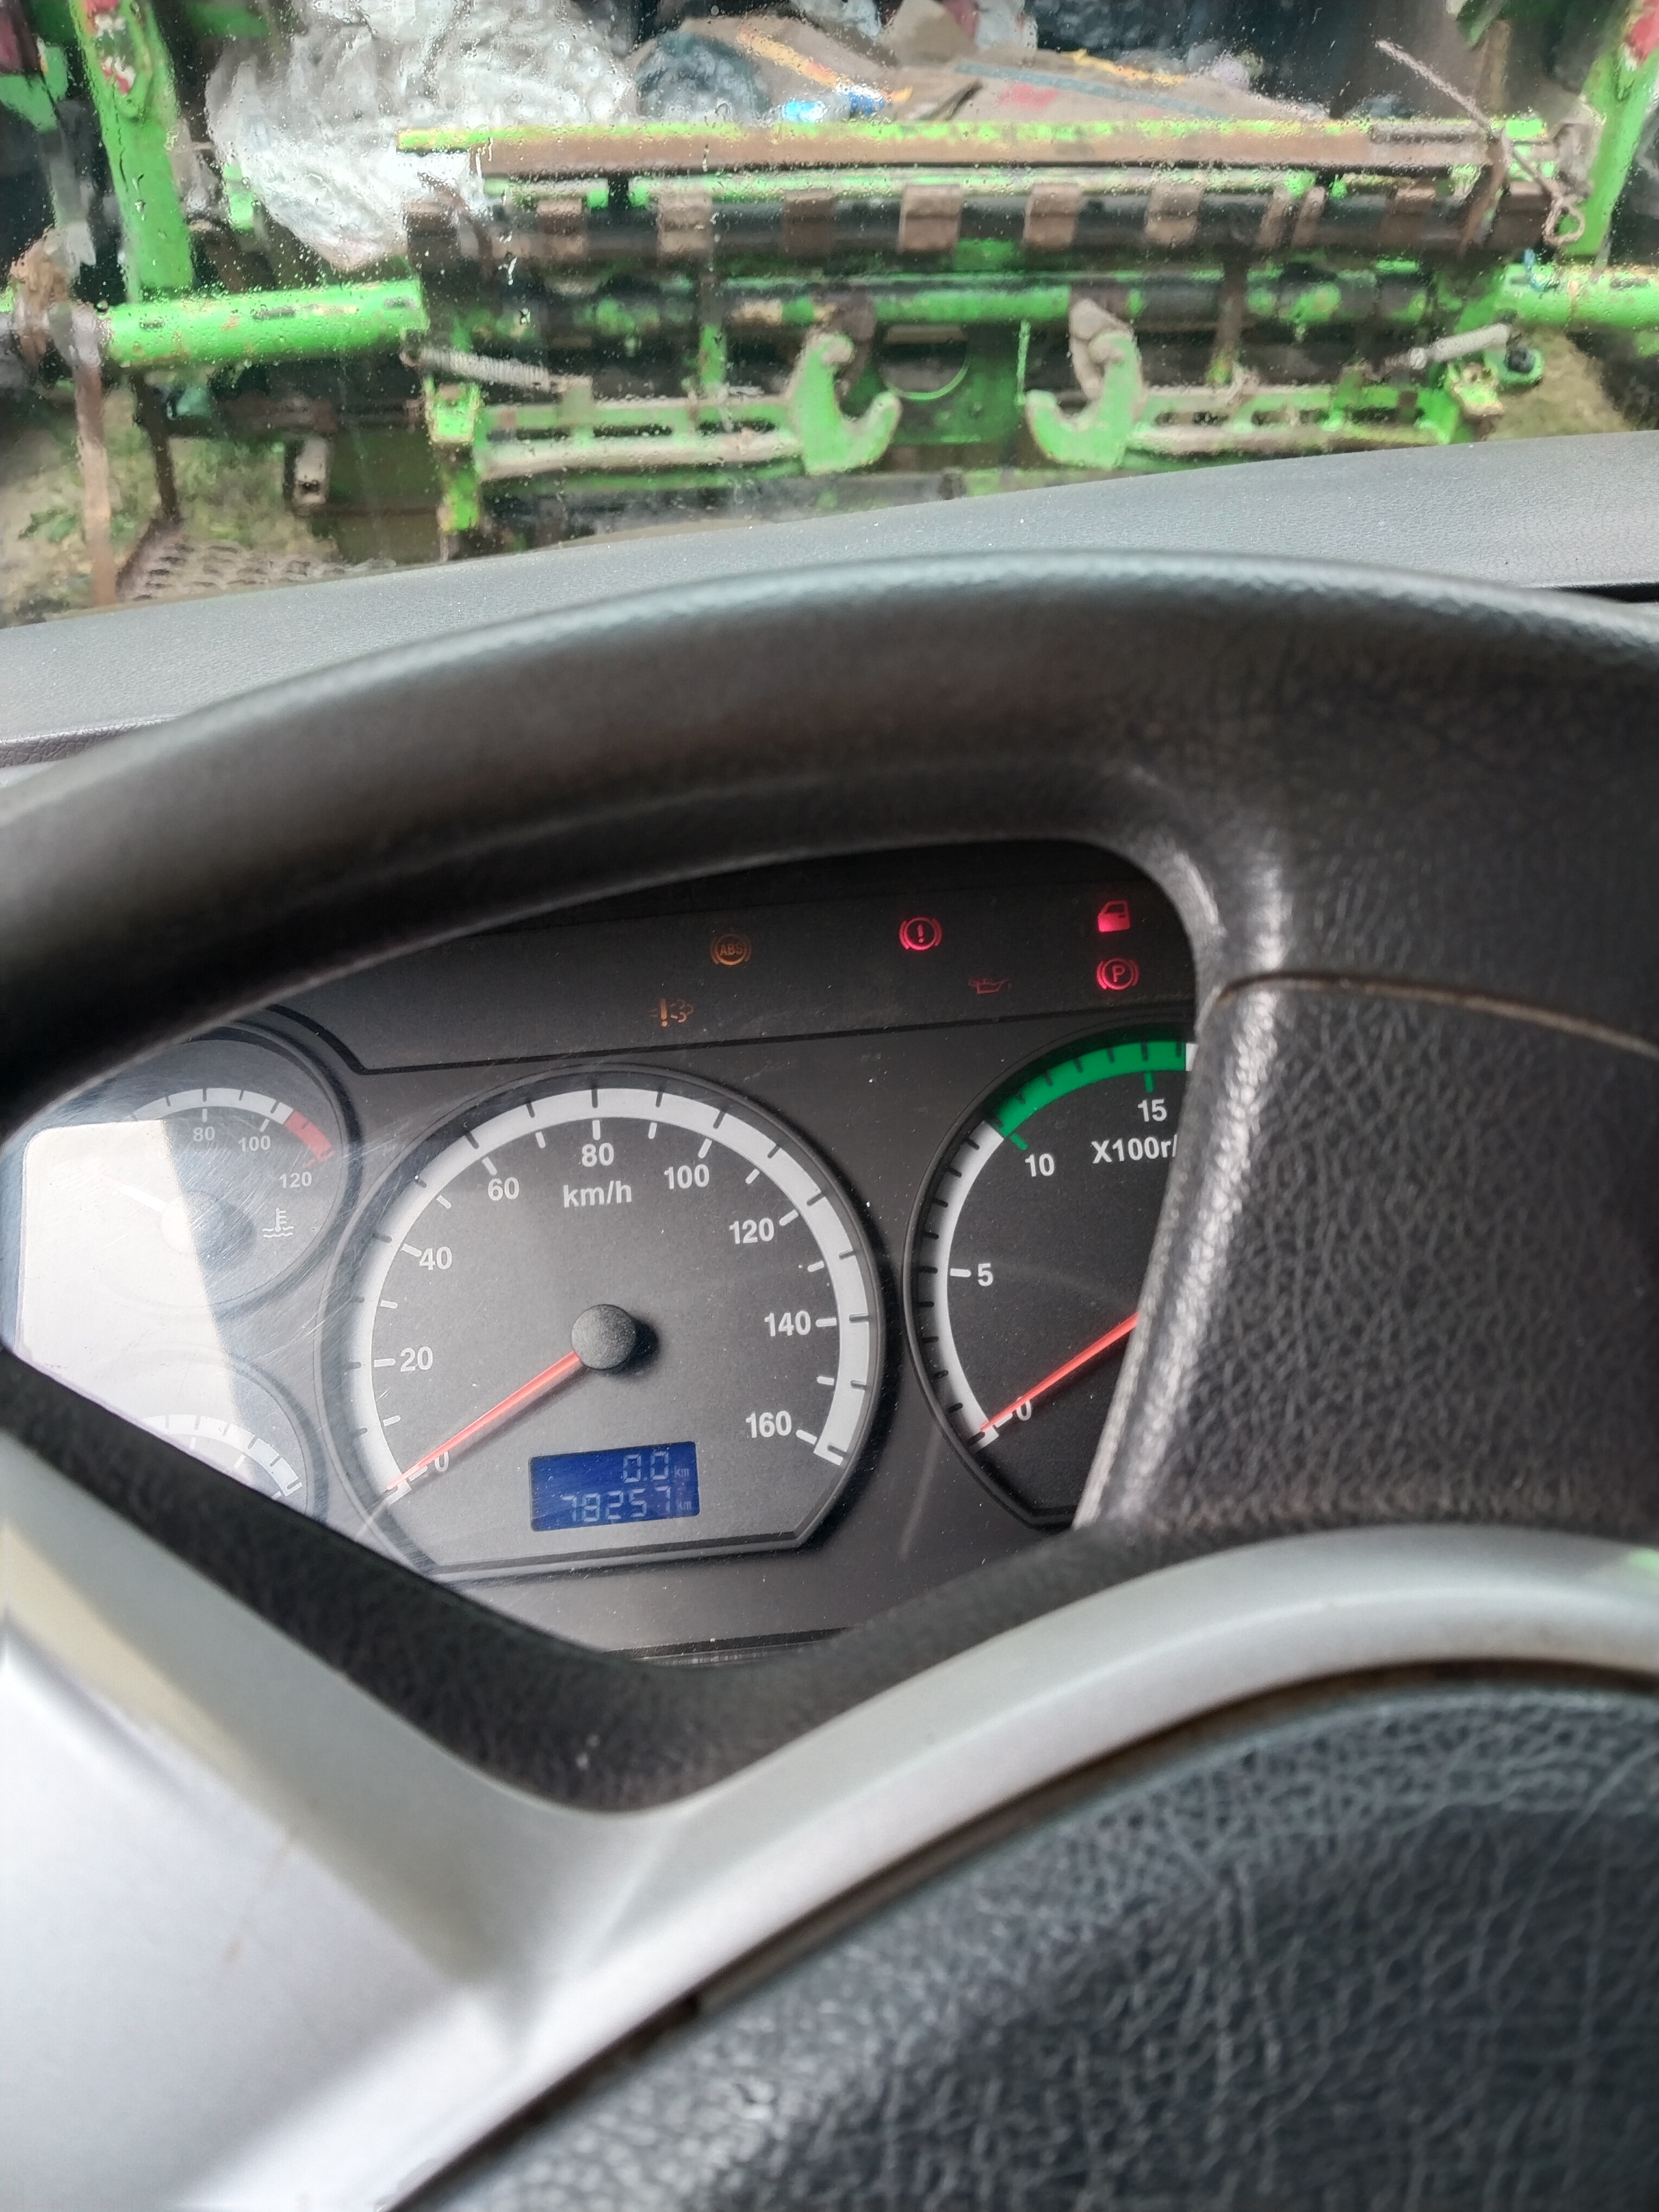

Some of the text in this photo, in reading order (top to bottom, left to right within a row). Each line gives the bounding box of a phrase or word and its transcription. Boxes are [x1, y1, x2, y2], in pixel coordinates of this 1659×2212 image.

[720, 944, 743, 956] ABS
[1137, 1099, 1168, 1122] 15
[192, 1126, 216, 1142] 80
[239, 1135, 271, 1152] 100
[581, 1143, 614, 1167] 80
[1091, 1134, 1178, 1164] X100r/
[664, 1163, 710, 1189] 100
[1025, 1153, 1055, 1177] 10
[280, 1172, 312, 1188] 120
[487, 1177, 520, 1201] 60
[563, 1180, 633, 1208] km/h
[729, 1218, 775, 1244] 120
[419, 1247, 453, 1270] 40
[978, 1263, 994, 1287] 5
[764, 1310, 812, 1336] 140
[400, 1346, 433, 1372] 20
[745, 1411, 792, 1438] 160
[623, 1451, 690, 1483] 0.0 km
[561, 1486, 672, 1522] 78257
